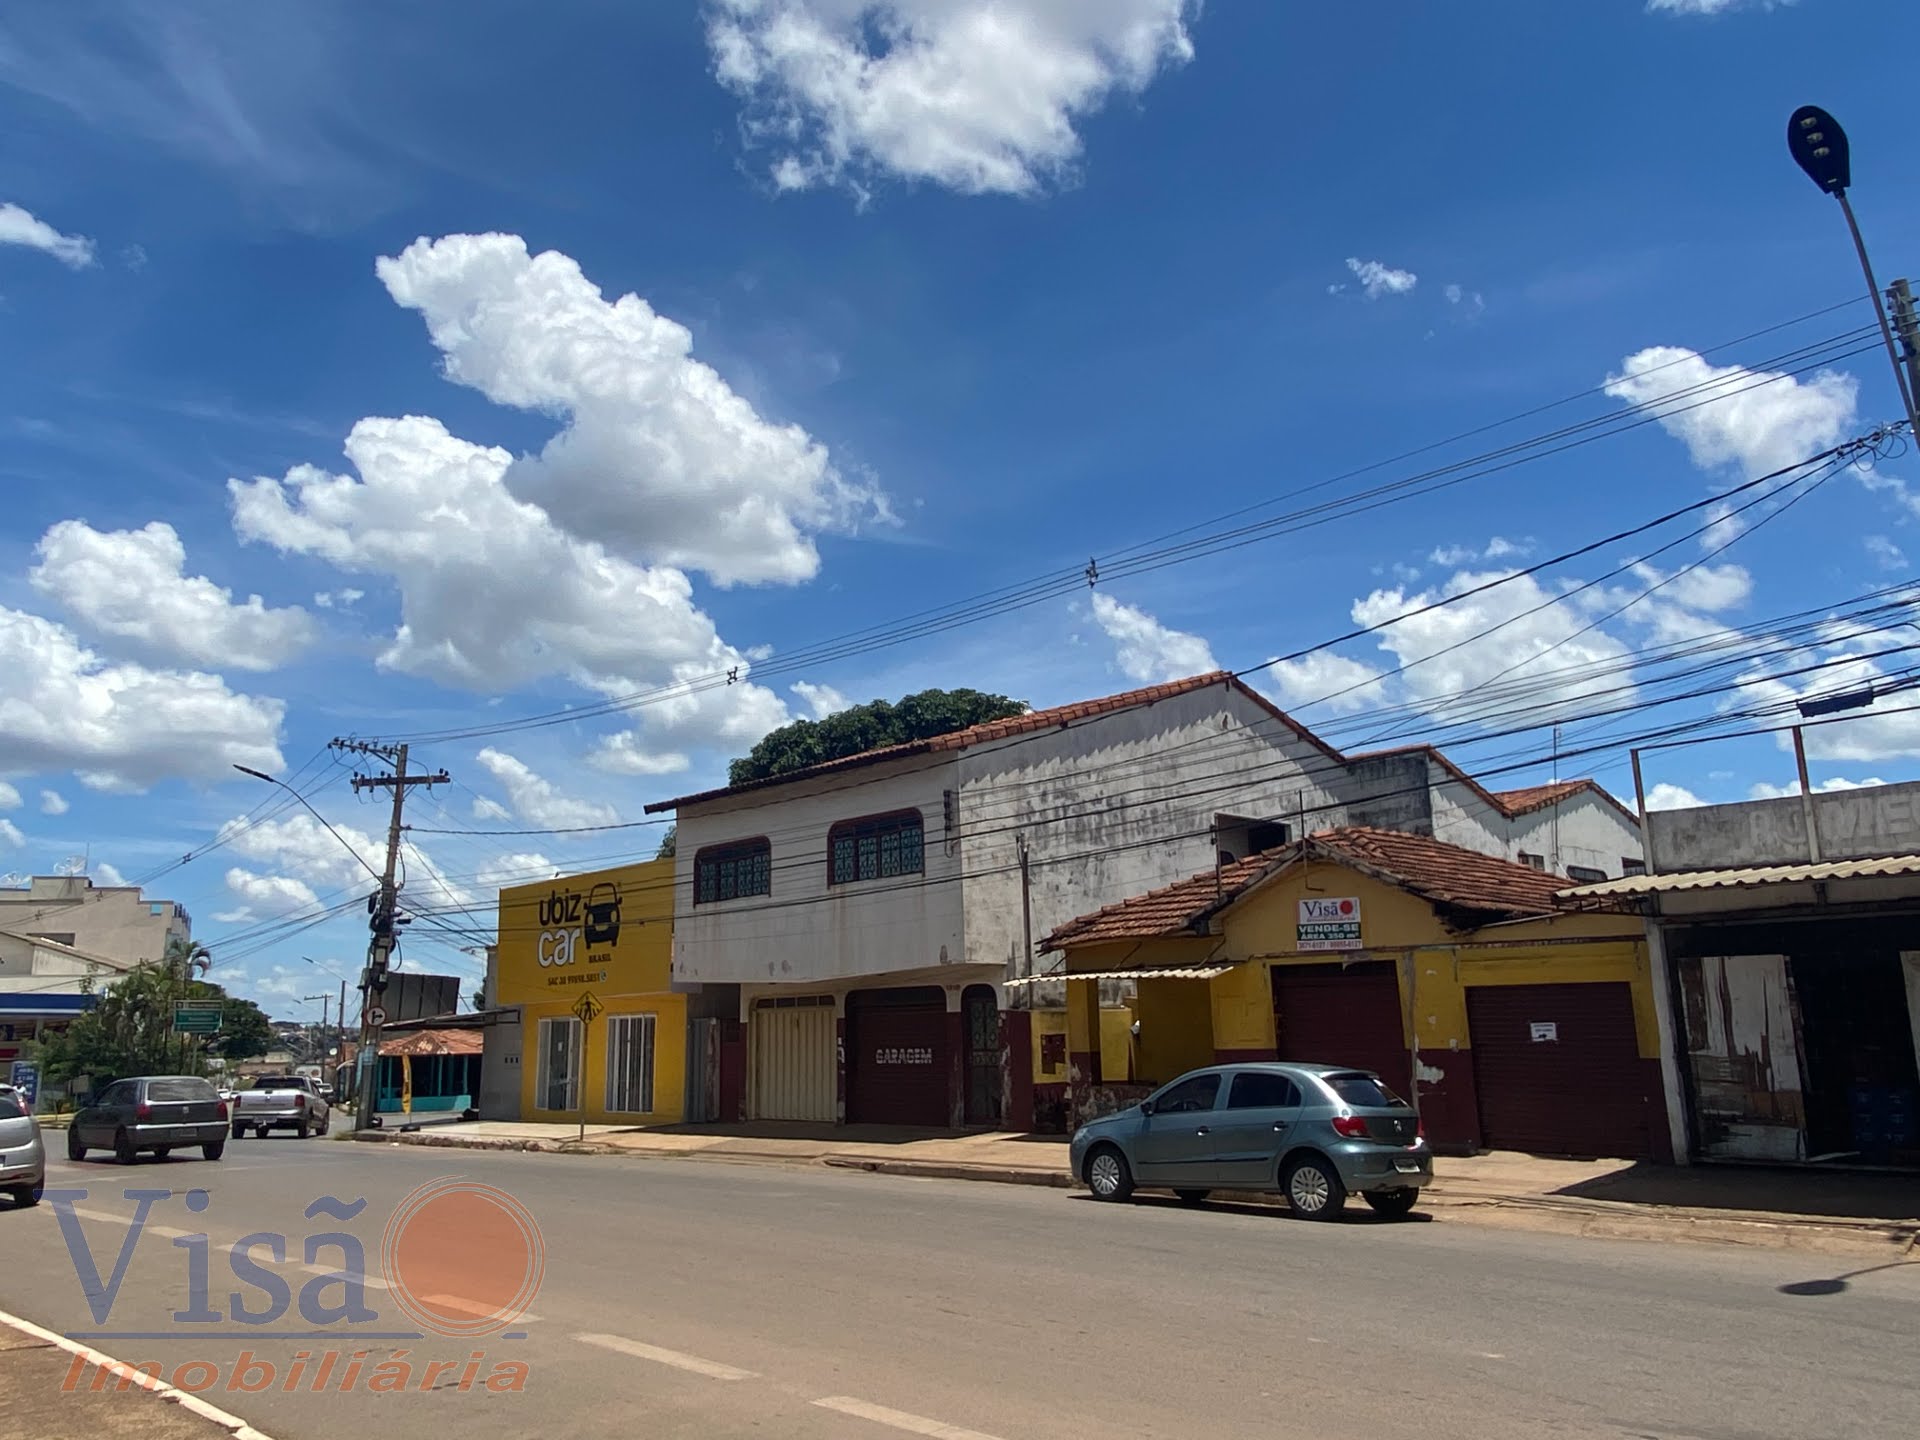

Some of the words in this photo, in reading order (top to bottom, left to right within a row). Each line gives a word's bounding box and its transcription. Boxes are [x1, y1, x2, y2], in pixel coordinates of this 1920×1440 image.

[538, 888, 582, 926] ubiz
[1298, 923, 1359, 933] VENDE-SE
[537, 927, 581, 968] car
[875, 1048, 932, 1064] GARAGEM
